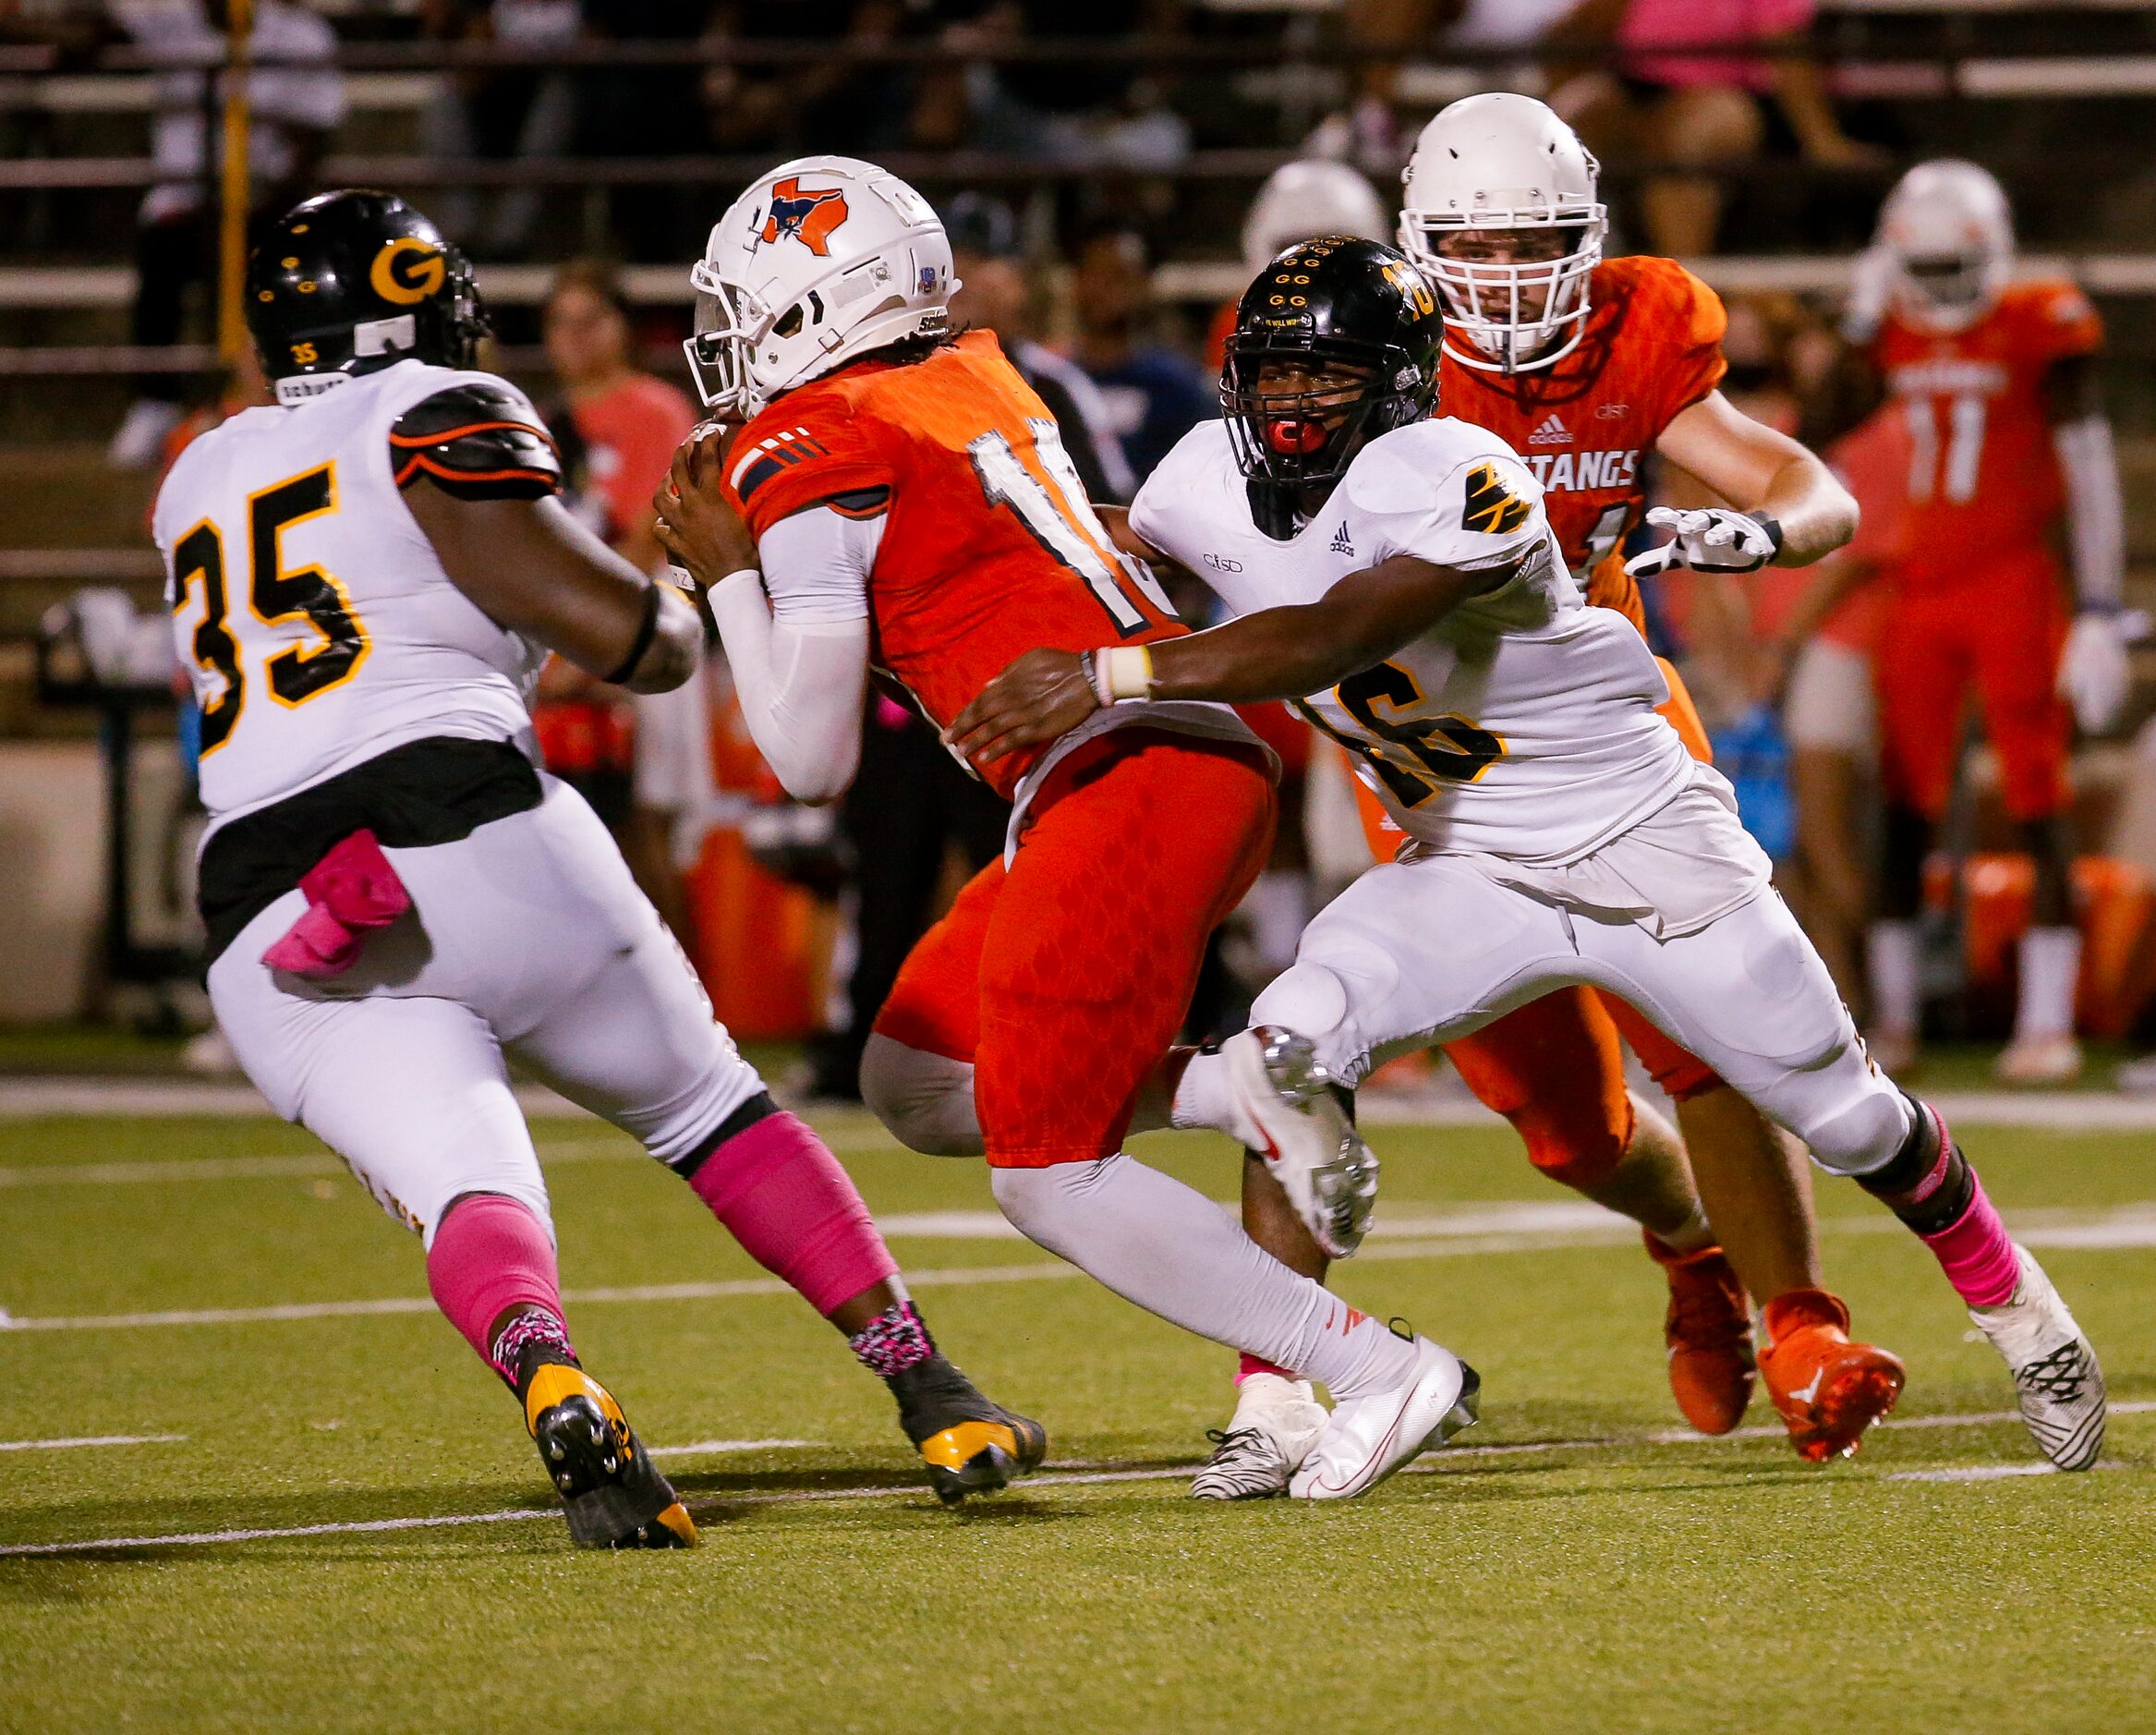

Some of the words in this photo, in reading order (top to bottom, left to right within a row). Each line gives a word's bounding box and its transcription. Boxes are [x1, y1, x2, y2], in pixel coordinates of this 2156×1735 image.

[370, 237, 445, 306] G
[1275, 274, 1290, 285] G
[1293, 274, 1310, 285] G
[1269, 295, 1285, 306] G
[1289, 295, 1307, 307] G
[289, 341, 319, 365] 35
[1329, 542, 1355, 558] adidas
[172, 458, 374, 762] 35
[1289, 658, 1509, 810] 16
